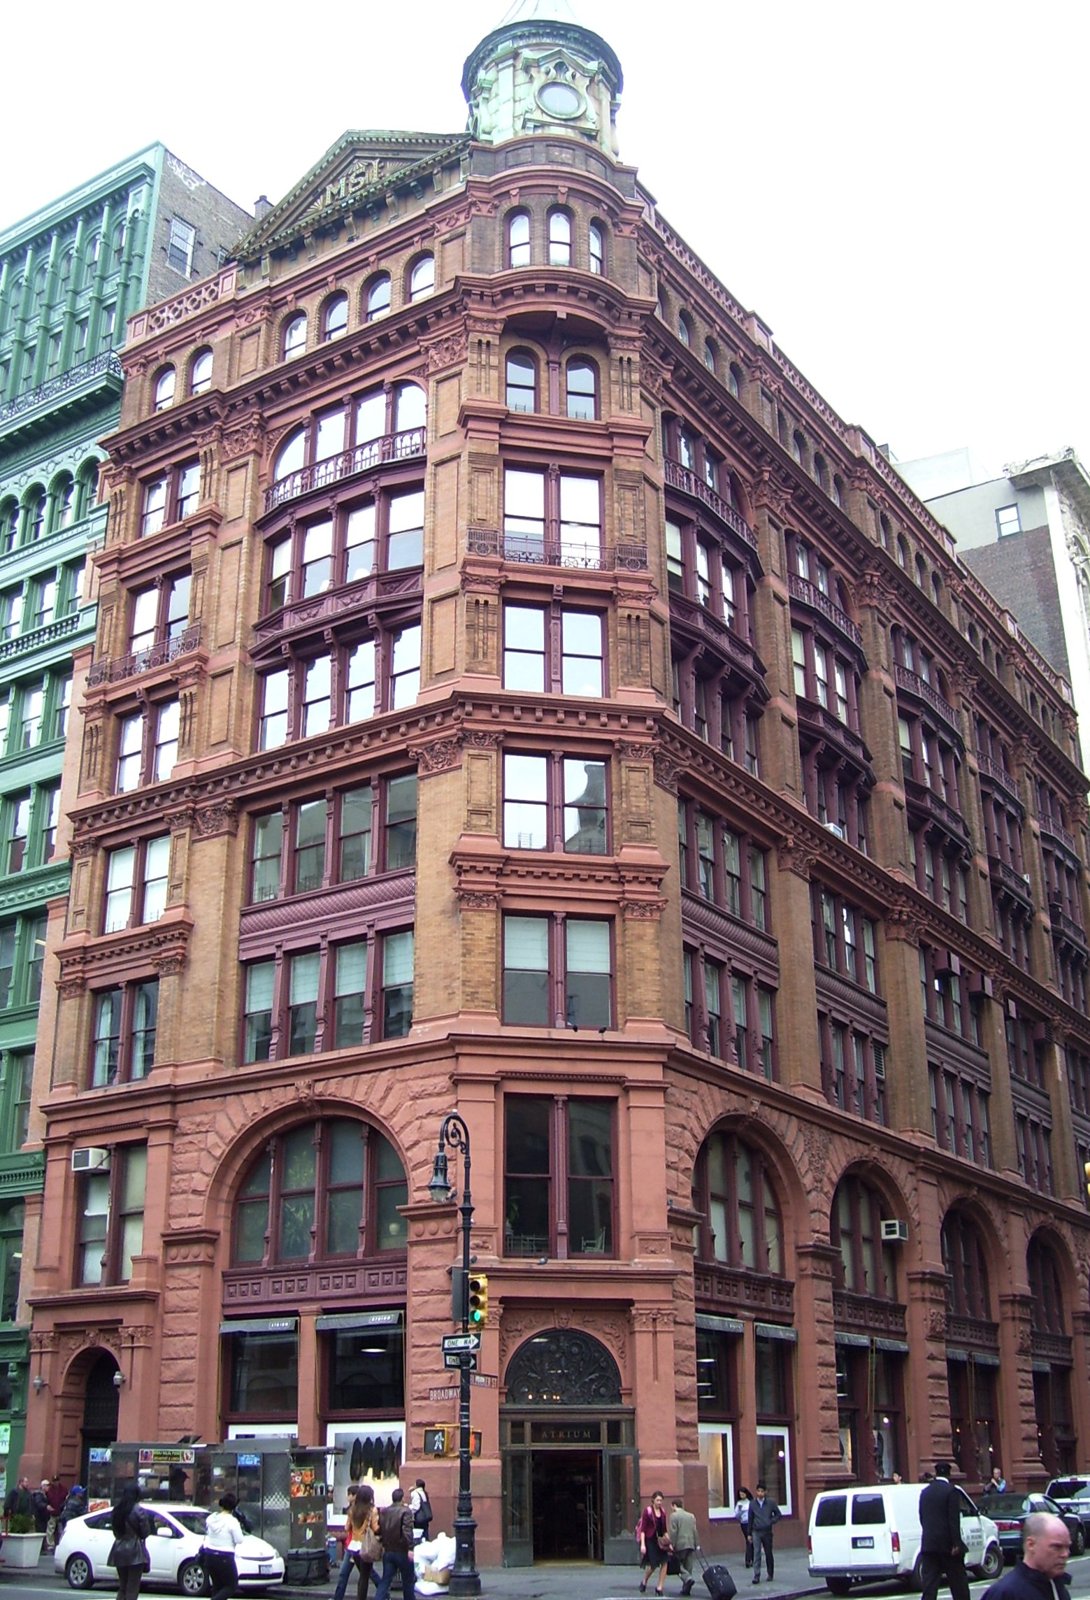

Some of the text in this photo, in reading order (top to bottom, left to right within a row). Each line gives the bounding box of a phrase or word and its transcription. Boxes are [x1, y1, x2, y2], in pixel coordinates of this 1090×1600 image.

[447, 1339, 458, 1347] ONE
[448, 1356, 459, 1364] ONE
[430, 1388, 460, 1400] BROADWAY
[542, 1430, 591, 1439] ATRIUM
